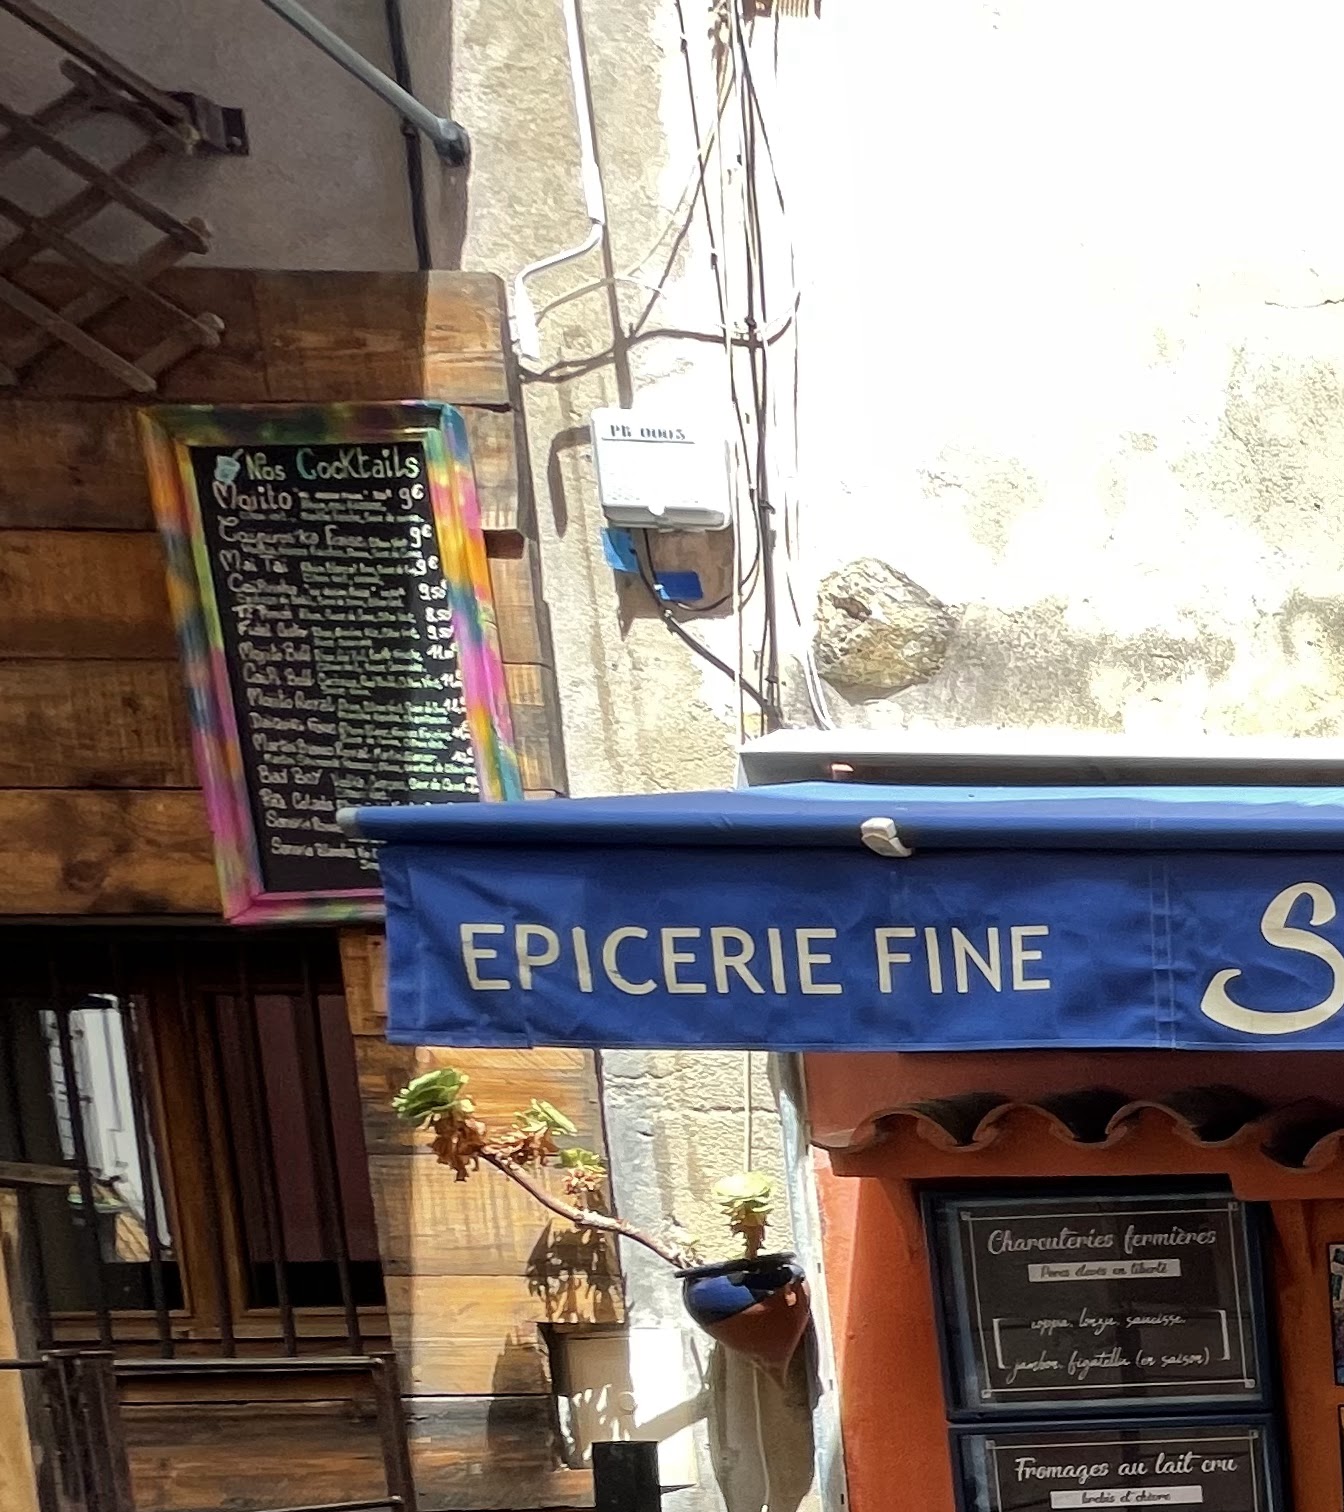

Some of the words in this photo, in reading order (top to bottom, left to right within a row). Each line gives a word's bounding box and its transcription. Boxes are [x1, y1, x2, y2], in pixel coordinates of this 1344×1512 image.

[246, 453, 287, 481] Nos
[212, 481, 293, 511] Mojito
[459, 922, 843, 996] EPICERIE
[875, 924, 1051, 994] FINE
[987, 1227, 1114, 1256] Charcuteries
[1123, 1224, 1217, 1255] fermières
[1014, 1456, 1110, 1485] Fromages
[1118, 1461, 1148, 1477] au
[1153, 1450, 1201, 1475] lait
[1200, 1457, 1238, 1474] cru
